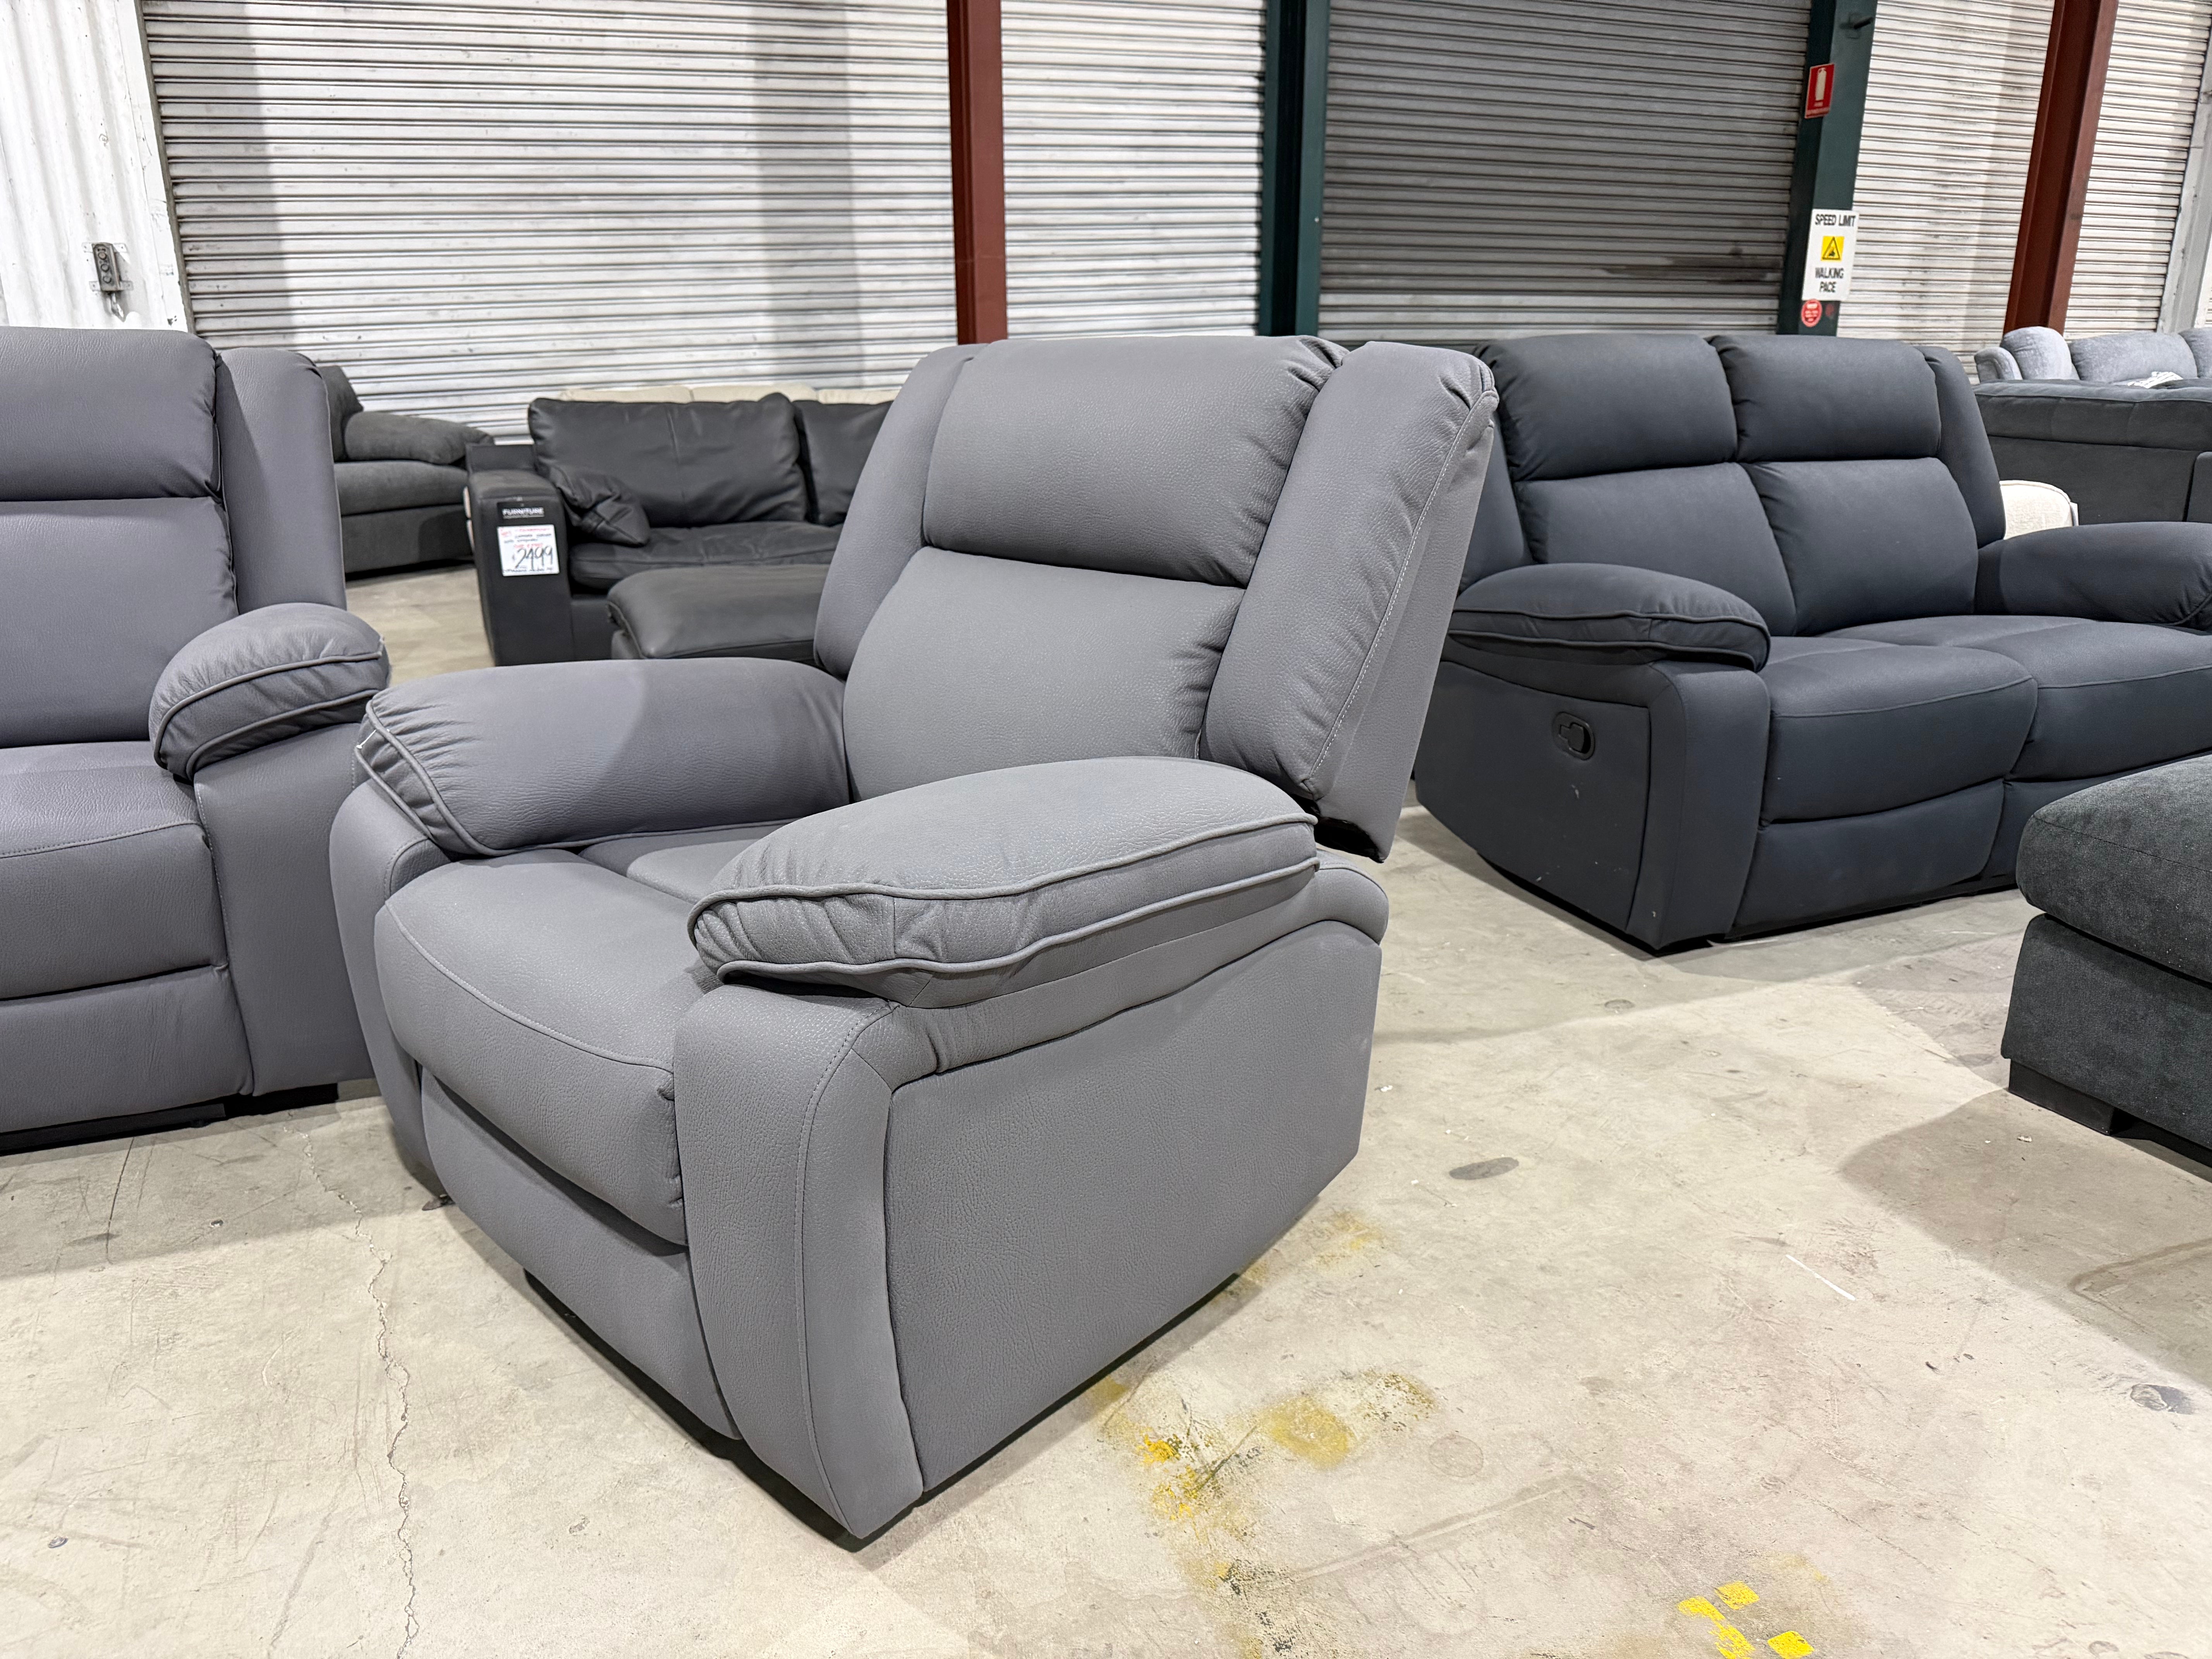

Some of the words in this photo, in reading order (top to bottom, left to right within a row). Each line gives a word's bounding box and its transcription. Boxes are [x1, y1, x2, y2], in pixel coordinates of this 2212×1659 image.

[1815, 214, 1837, 226] SPEED
[1838, 215, 1856, 227] LIMIT
[1815, 267, 1844, 279] WALKING
[1819, 282, 1837, 293] PACE
